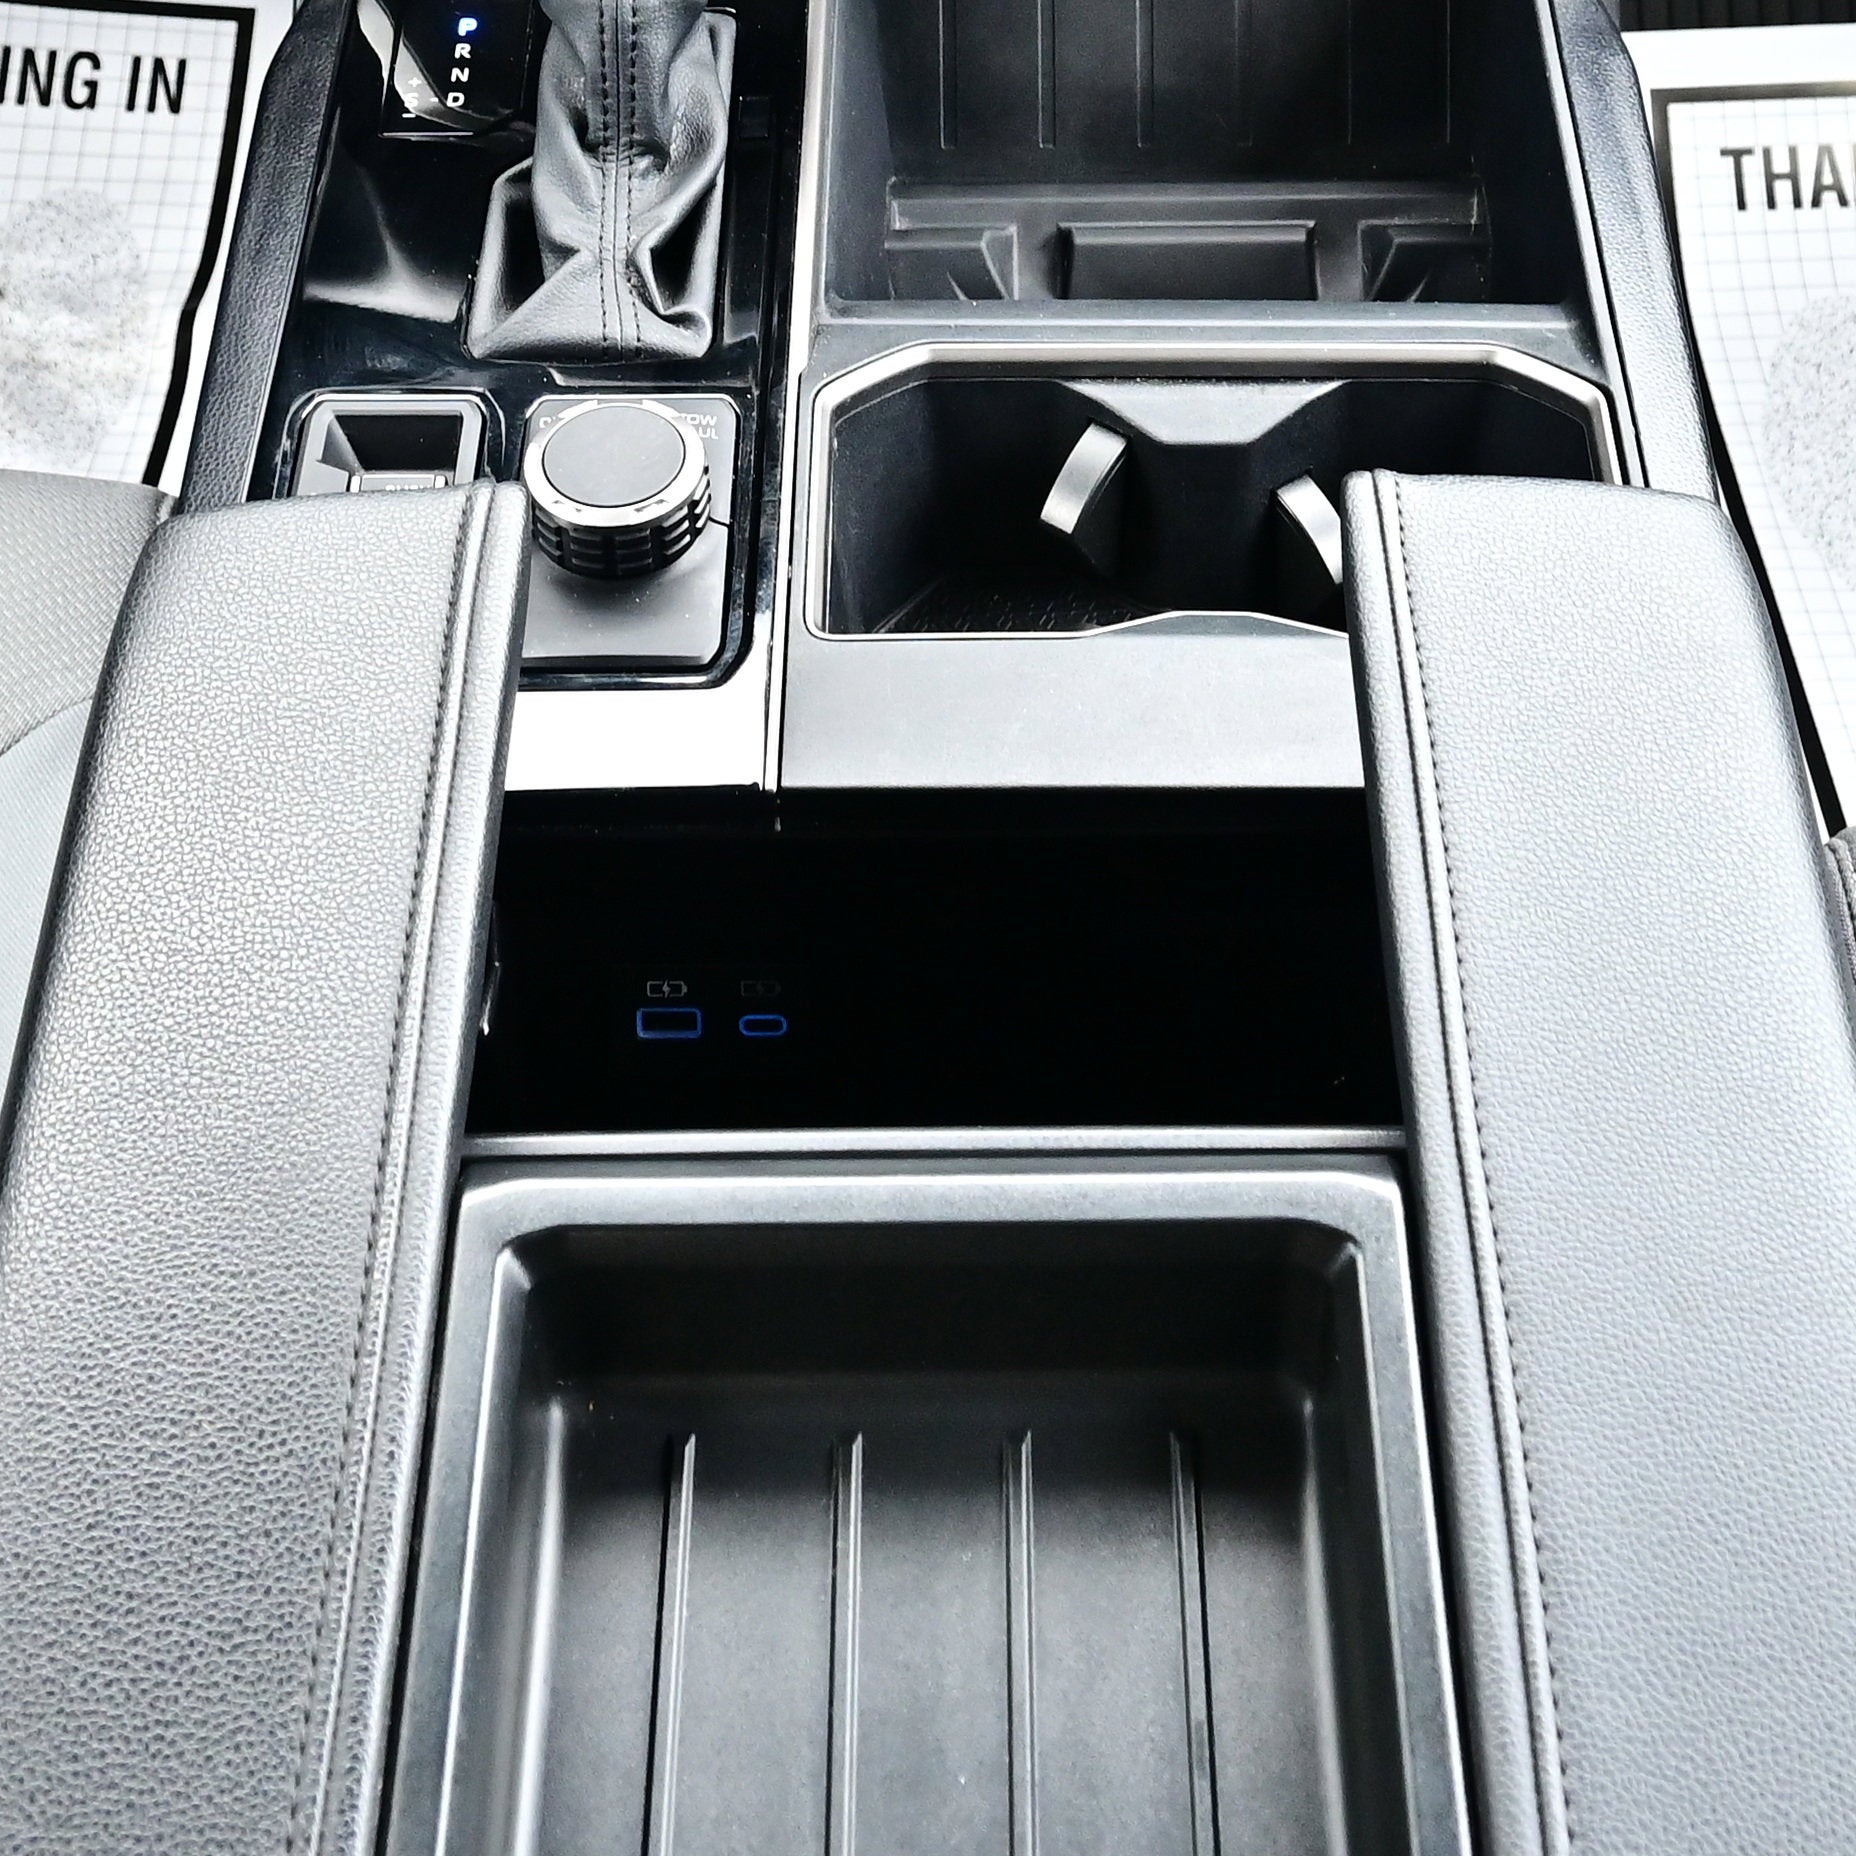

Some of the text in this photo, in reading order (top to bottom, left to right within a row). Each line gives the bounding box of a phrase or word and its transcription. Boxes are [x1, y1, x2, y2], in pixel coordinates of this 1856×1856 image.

[457, 16, 479, 37] P
[453, 42, 472, 60] R
[450, 67, 470, 83] N
[124, 55, 188, 115] IN
[446, 92, 466, 108] D
